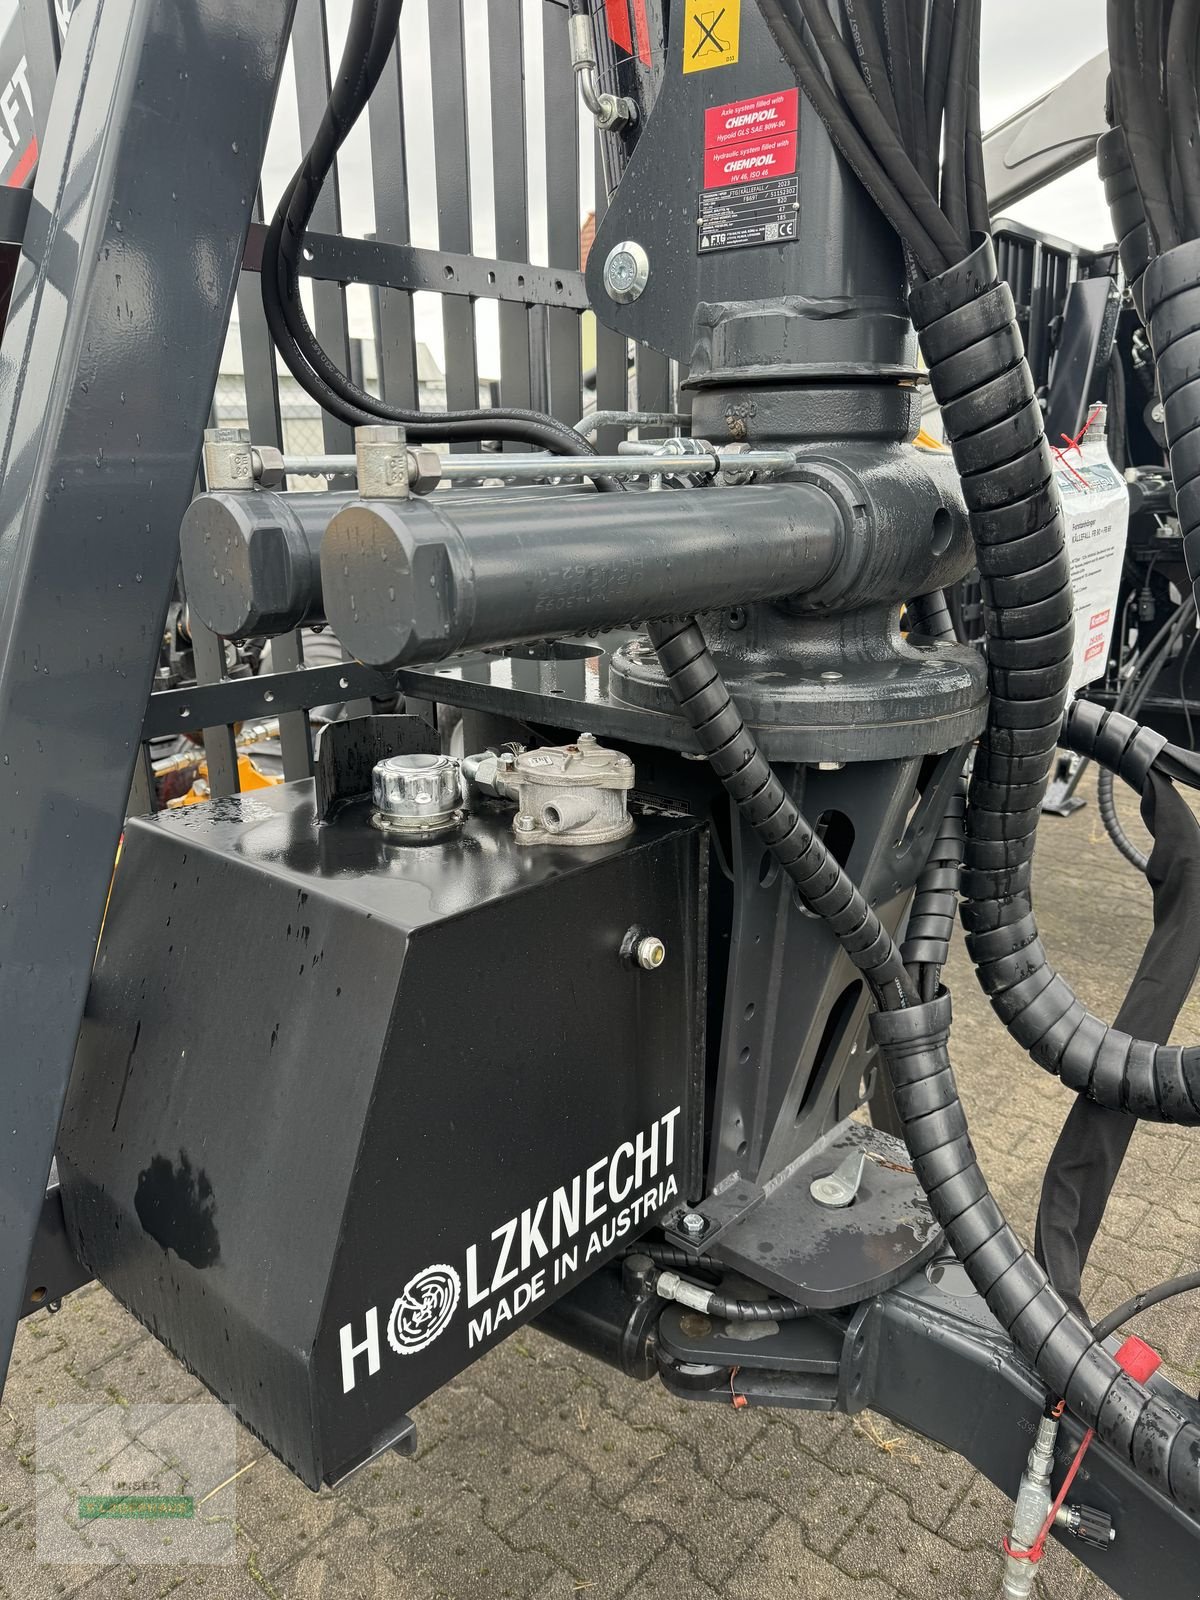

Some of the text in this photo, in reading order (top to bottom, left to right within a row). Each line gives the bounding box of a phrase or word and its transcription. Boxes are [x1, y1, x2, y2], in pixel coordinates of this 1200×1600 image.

[721, 96, 785, 117] Axle system filled with
[717, 130, 737, 142] Hypoid
[751, 124, 764, 134] SAE
[713, 139, 790, 162] Hydraulic system filled with
[749, 170, 761, 179] ISO
[777, 180, 791, 188] 2023
[710, 233, 726, 244] FTG
[335, 371, 348, 384] bar
[467, 1173, 679, 1349] MADE IN AUSTRIA
